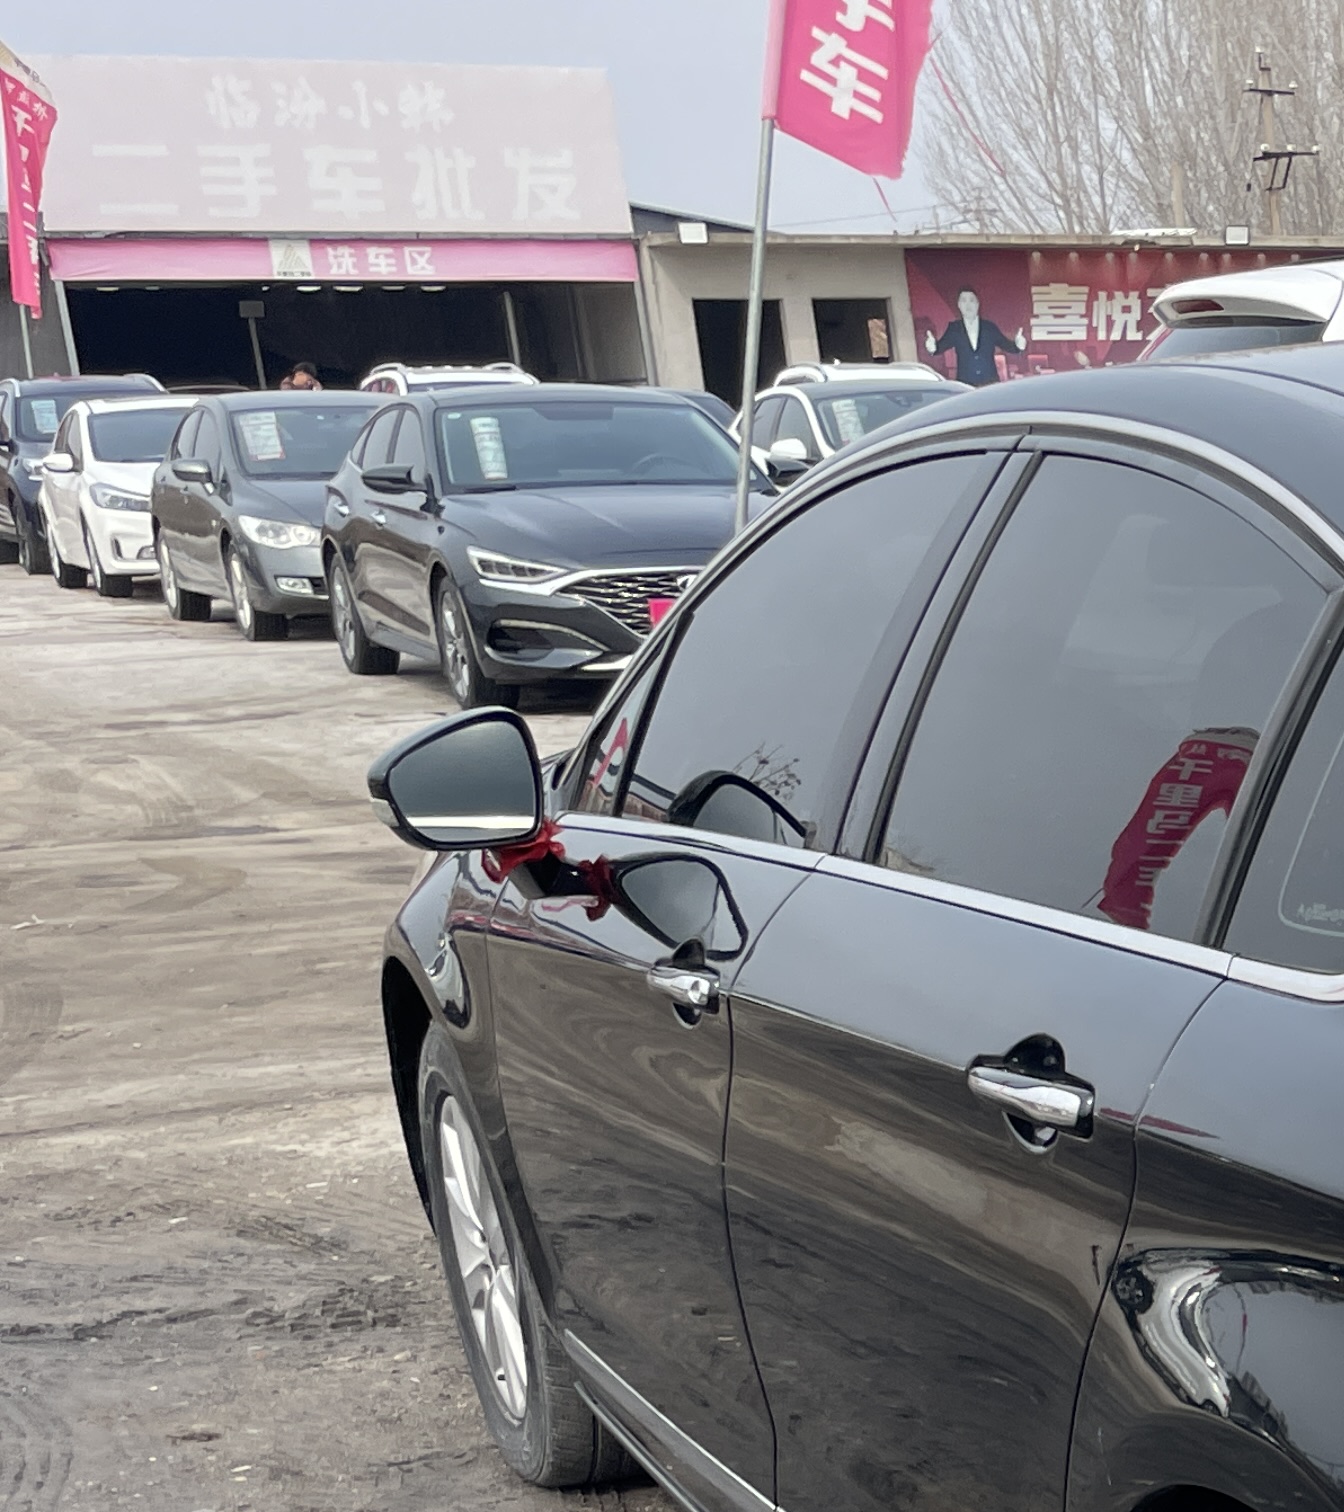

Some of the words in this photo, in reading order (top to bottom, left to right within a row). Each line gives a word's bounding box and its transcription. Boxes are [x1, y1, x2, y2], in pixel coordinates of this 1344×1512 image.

[91, 143, 582, 221] 二手车批发
[326, 245, 437, 275] 洗车区
